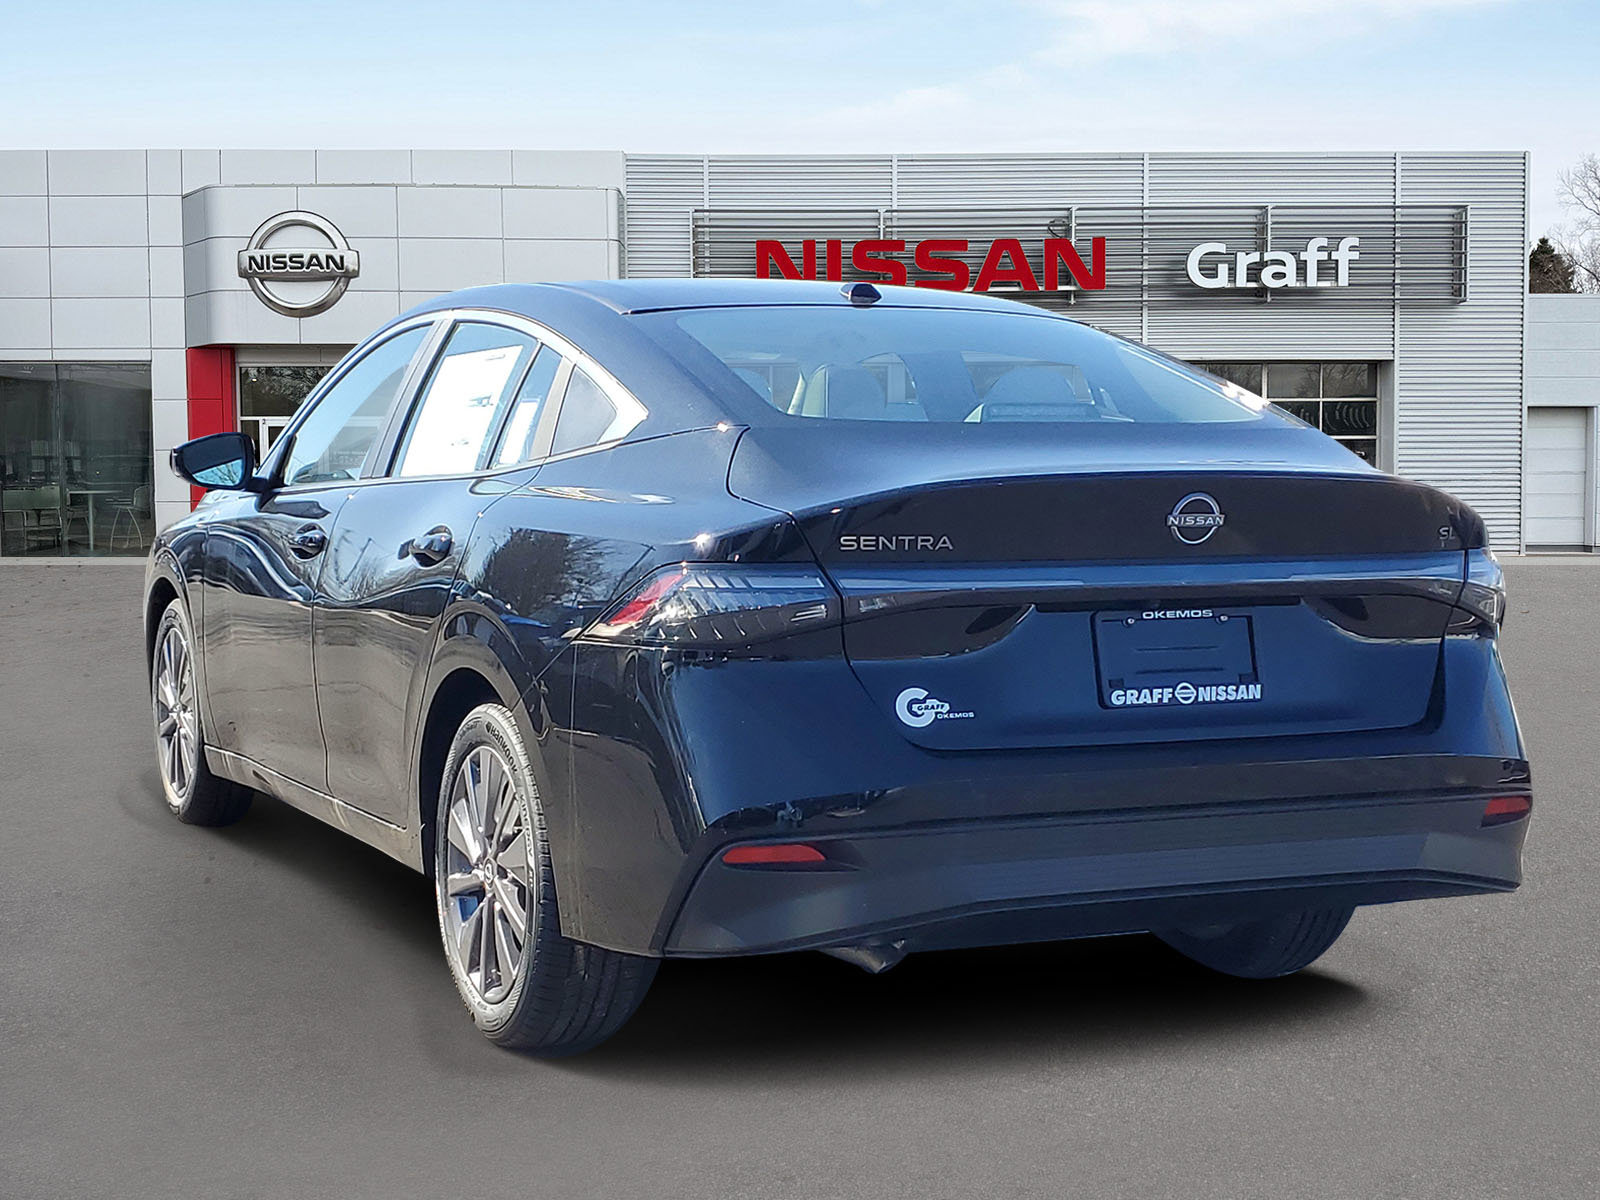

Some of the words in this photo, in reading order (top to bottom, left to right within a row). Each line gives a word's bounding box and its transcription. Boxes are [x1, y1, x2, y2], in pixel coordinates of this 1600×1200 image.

[247, 253, 345, 271] NISSAN
[755, 237, 1106, 292] NISSAN
[1186, 237, 1360, 289] Graff
[1167, 516, 1224, 526] NISSAN
[1439, 526, 1456, 540] SL
[840, 535, 954, 551] SENTRA
[1142, 609, 1213, 619] OKEMOS
[1111, 687, 1173, 705] GRAFF
[1198, 684, 1262, 702] NISSAN
[916, 703, 945, 711] GRAFF
[937, 711, 975, 719] OKEMOS
